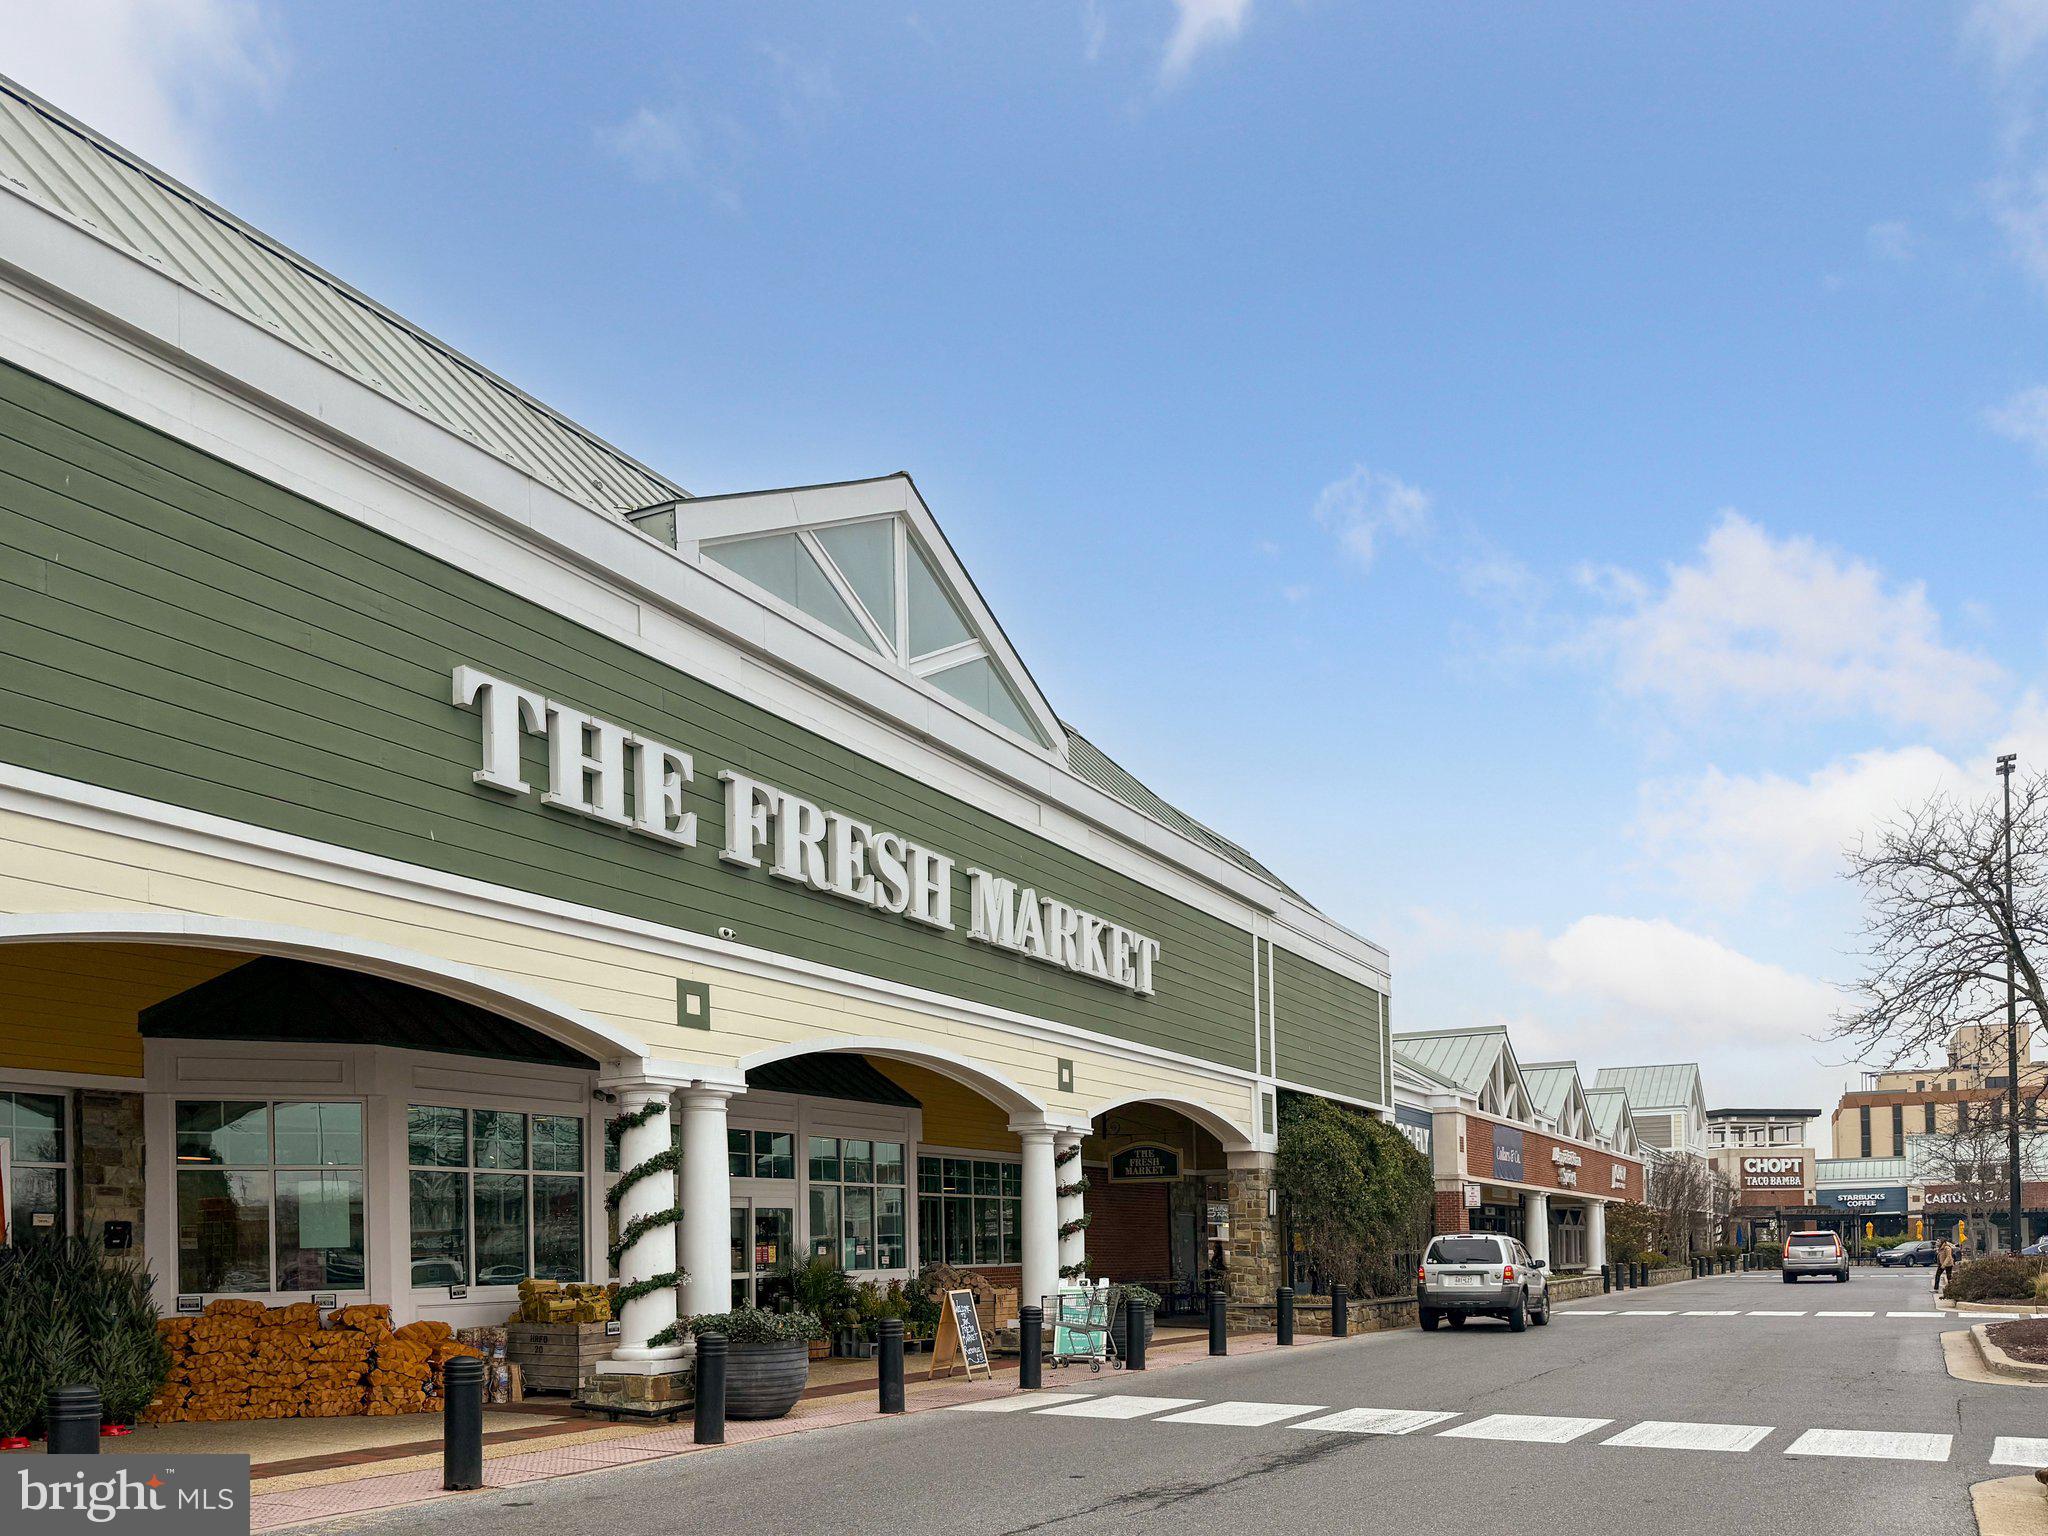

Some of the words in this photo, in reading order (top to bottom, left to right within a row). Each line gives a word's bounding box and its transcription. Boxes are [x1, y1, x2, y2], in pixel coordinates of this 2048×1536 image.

[452, 665, 698, 848] THE
[717, 769, 956, 931] FRESH
[966, 866, 1161, 998] MARKET
[1136, 1149, 1155, 1158] THE
[1130, 1158, 1160, 1167] FRESH
[1743, 1158, 1802, 1173] CHOPT
[1125, 1166, 1166, 1175] MARKET
[1744, 1176, 1769, 1186] TACO
[1769, 1176, 1802, 1186] BAMBA
[1837, 1193, 1886, 1202] STARBUCKS
